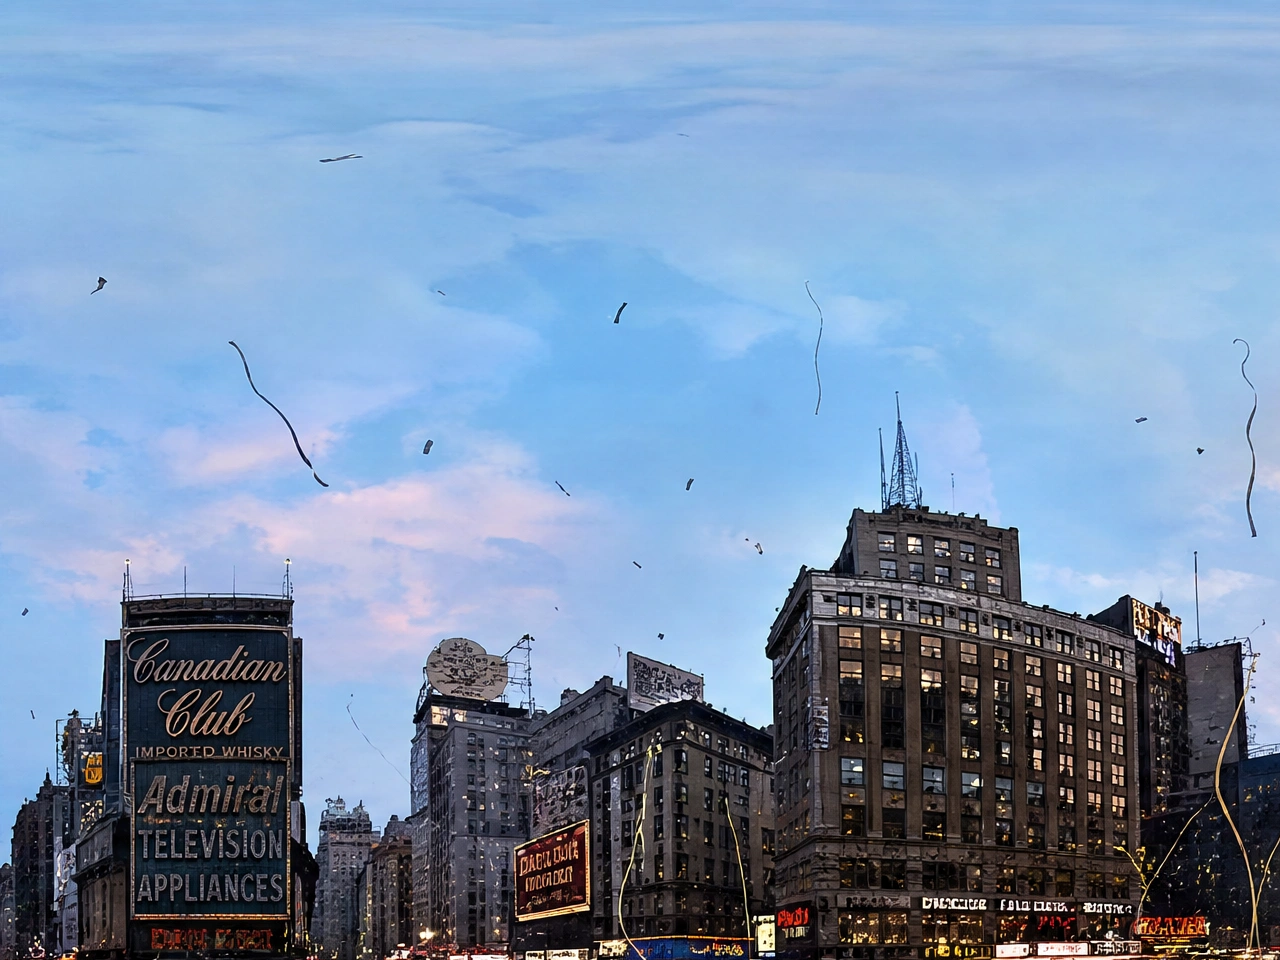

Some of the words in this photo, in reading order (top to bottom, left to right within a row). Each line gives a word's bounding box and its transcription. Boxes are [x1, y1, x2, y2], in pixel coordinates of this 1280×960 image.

[127, 638, 287, 684] Canadian
[157, 689, 256, 737] Club
[136, 746, 215, 758] IMPORTED
[222, 746, 284, 758] WHISKY
[137, 775, 285, 814] Admiral
[138, 829, 283, 859] TELEVISION
[137, 873, 283, 902] APPLIANCES
